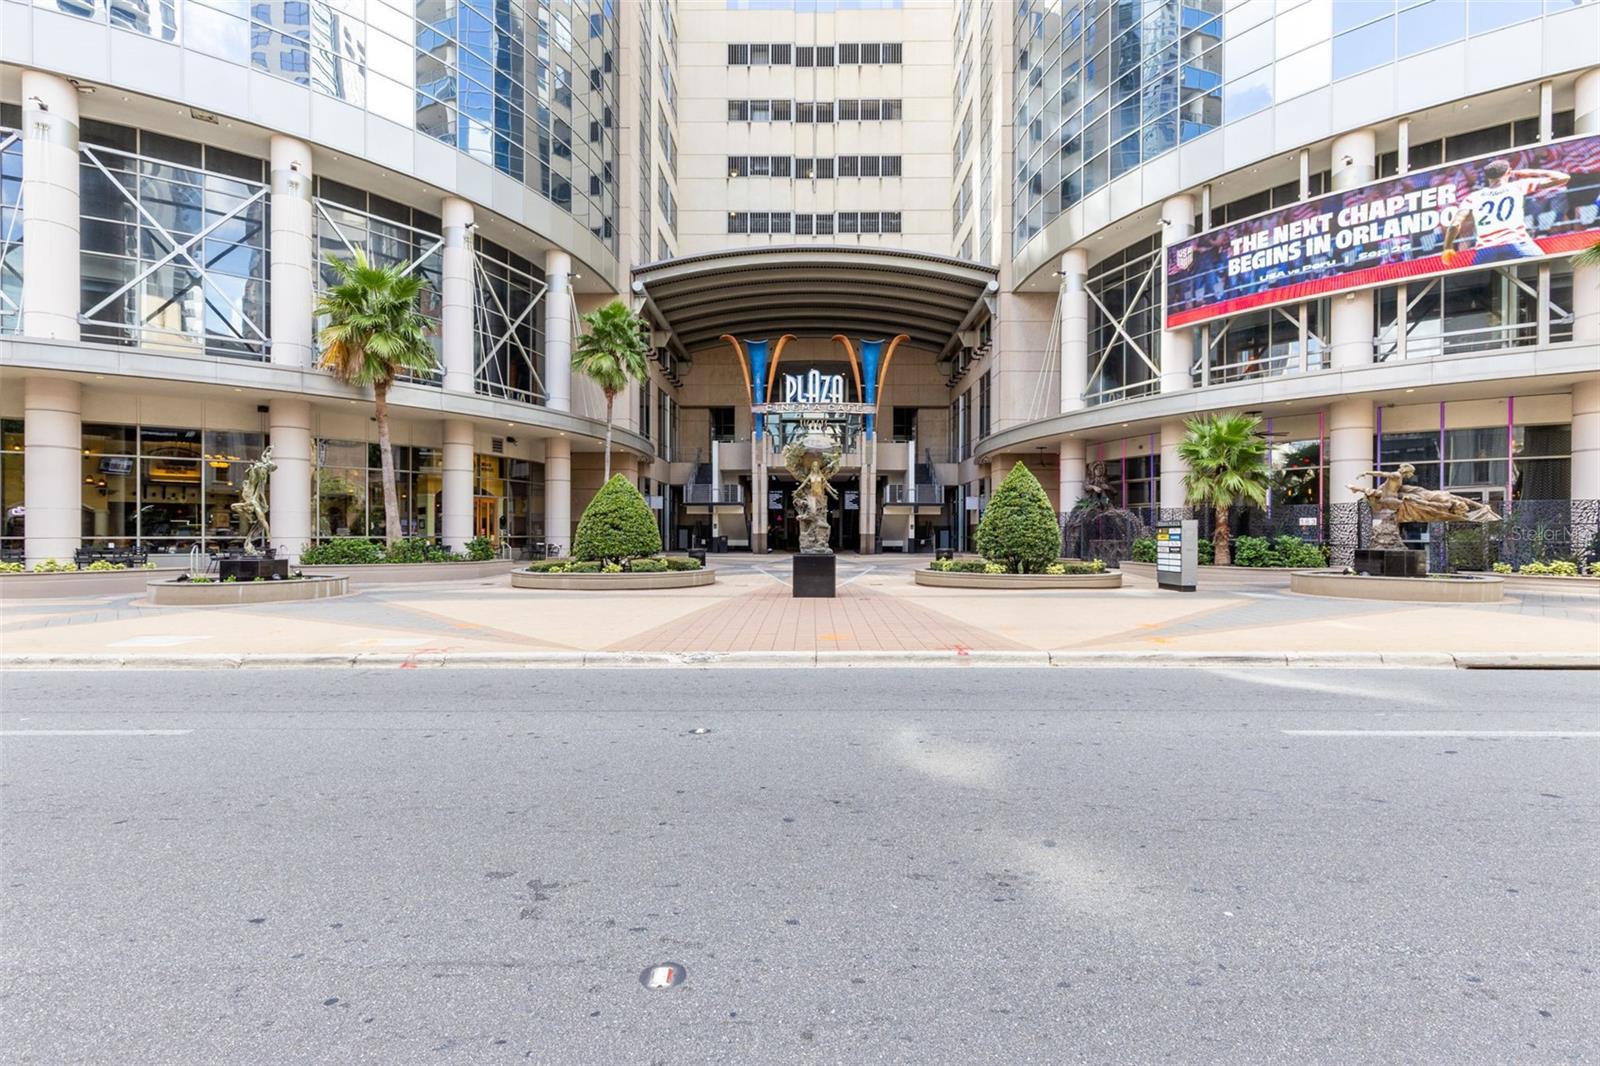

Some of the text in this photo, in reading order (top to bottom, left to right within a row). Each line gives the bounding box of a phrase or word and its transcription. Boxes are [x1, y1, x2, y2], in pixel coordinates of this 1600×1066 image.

[1230, 183, 1457, 256] THE NEXT CHAPTER
[1478, 196, 1515, 226] 20
[1228, 206, 1460, 276] BEGINS IN ORLANDO
[1259, 271, 1289, 282] USA
[1301, 261, 1337, 273] Peru
[785, 369, 844, 403] PLAZA
[765, 404, 822, 412] CINEMA
